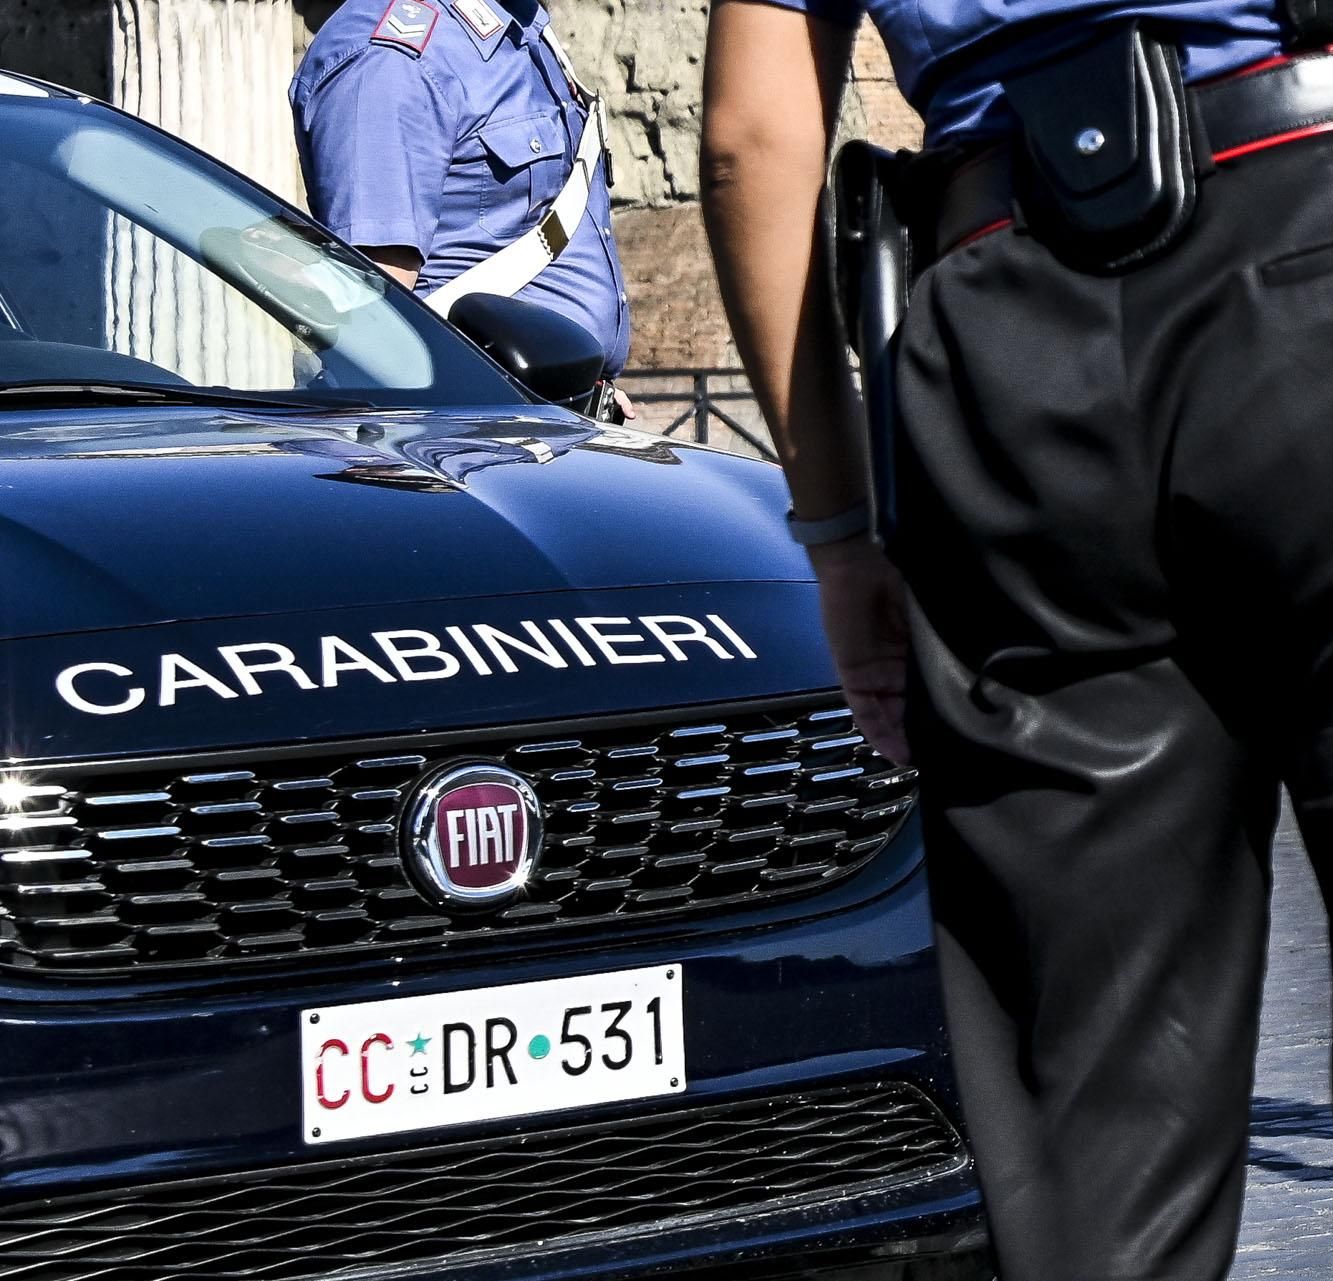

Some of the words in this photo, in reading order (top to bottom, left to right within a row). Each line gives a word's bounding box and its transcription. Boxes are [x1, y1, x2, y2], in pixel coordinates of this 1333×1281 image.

[55, 614, 758, 715] CARABINIERI
[446, 803, 518, 868] FIAT
[314, 1032, 395, 1109] CC
[443, 1016, 518, 1095] DR
[560, 996, 663, 1077] 531
